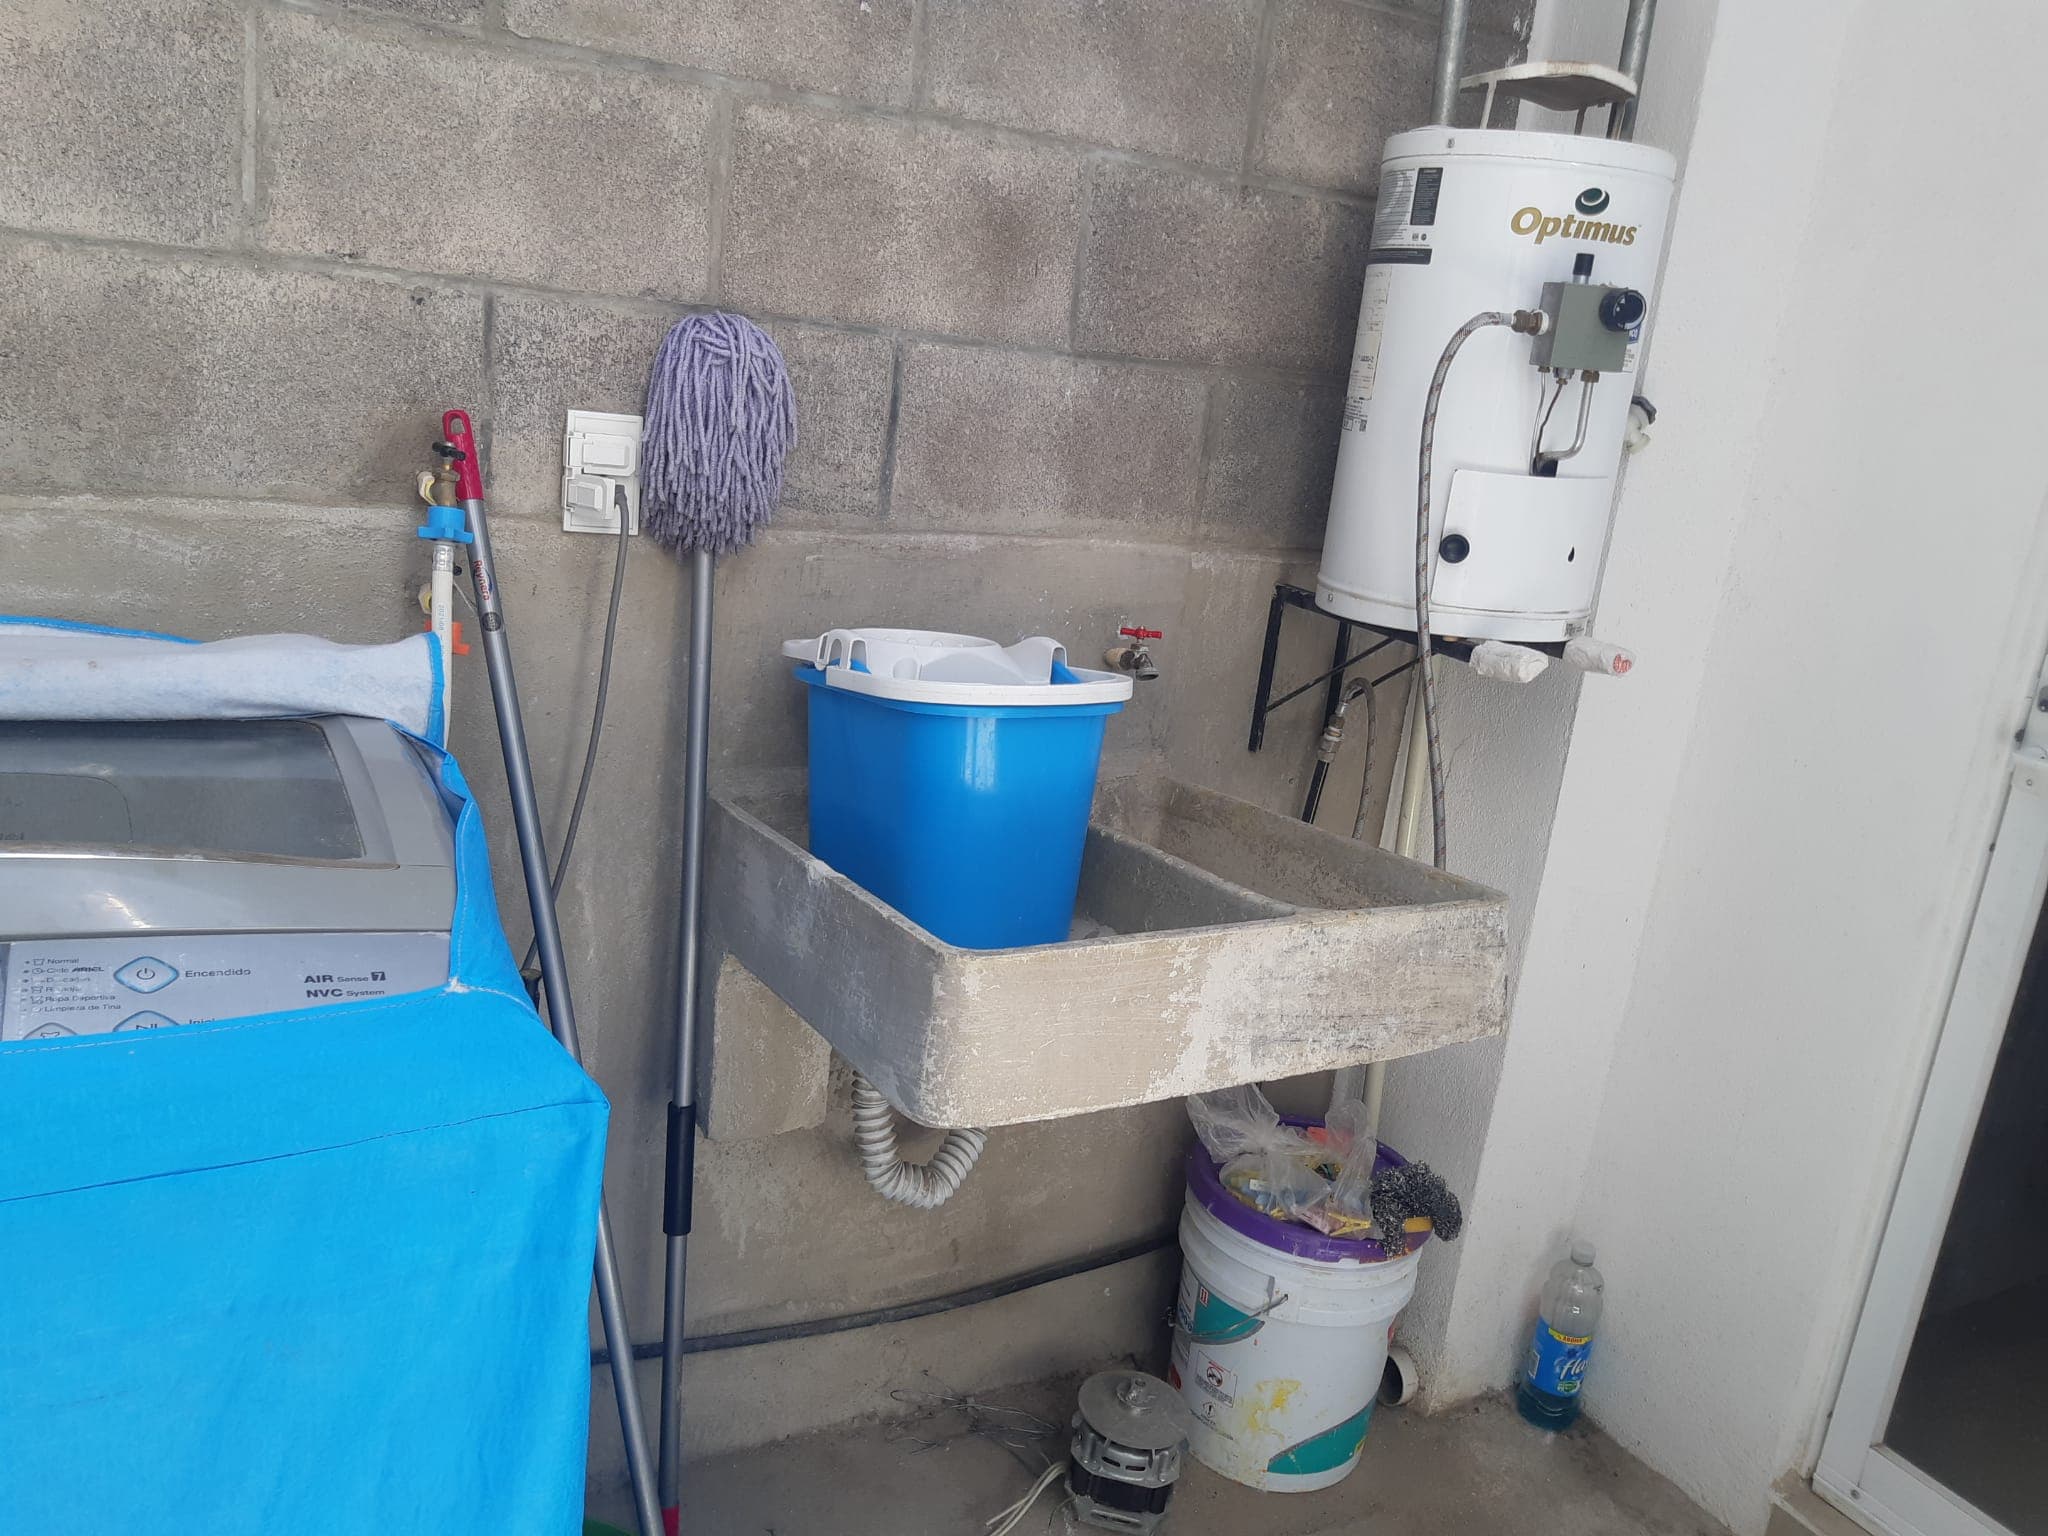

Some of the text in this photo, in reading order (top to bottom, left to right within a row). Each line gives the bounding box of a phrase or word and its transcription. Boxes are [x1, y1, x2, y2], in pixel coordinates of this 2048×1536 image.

[1510, 206, 1638, 246] Optimus
[185, 968, 252, 978] Encendido
[304, 974, 334, 984] AIR
[306, 988, 343, 998] NVC
